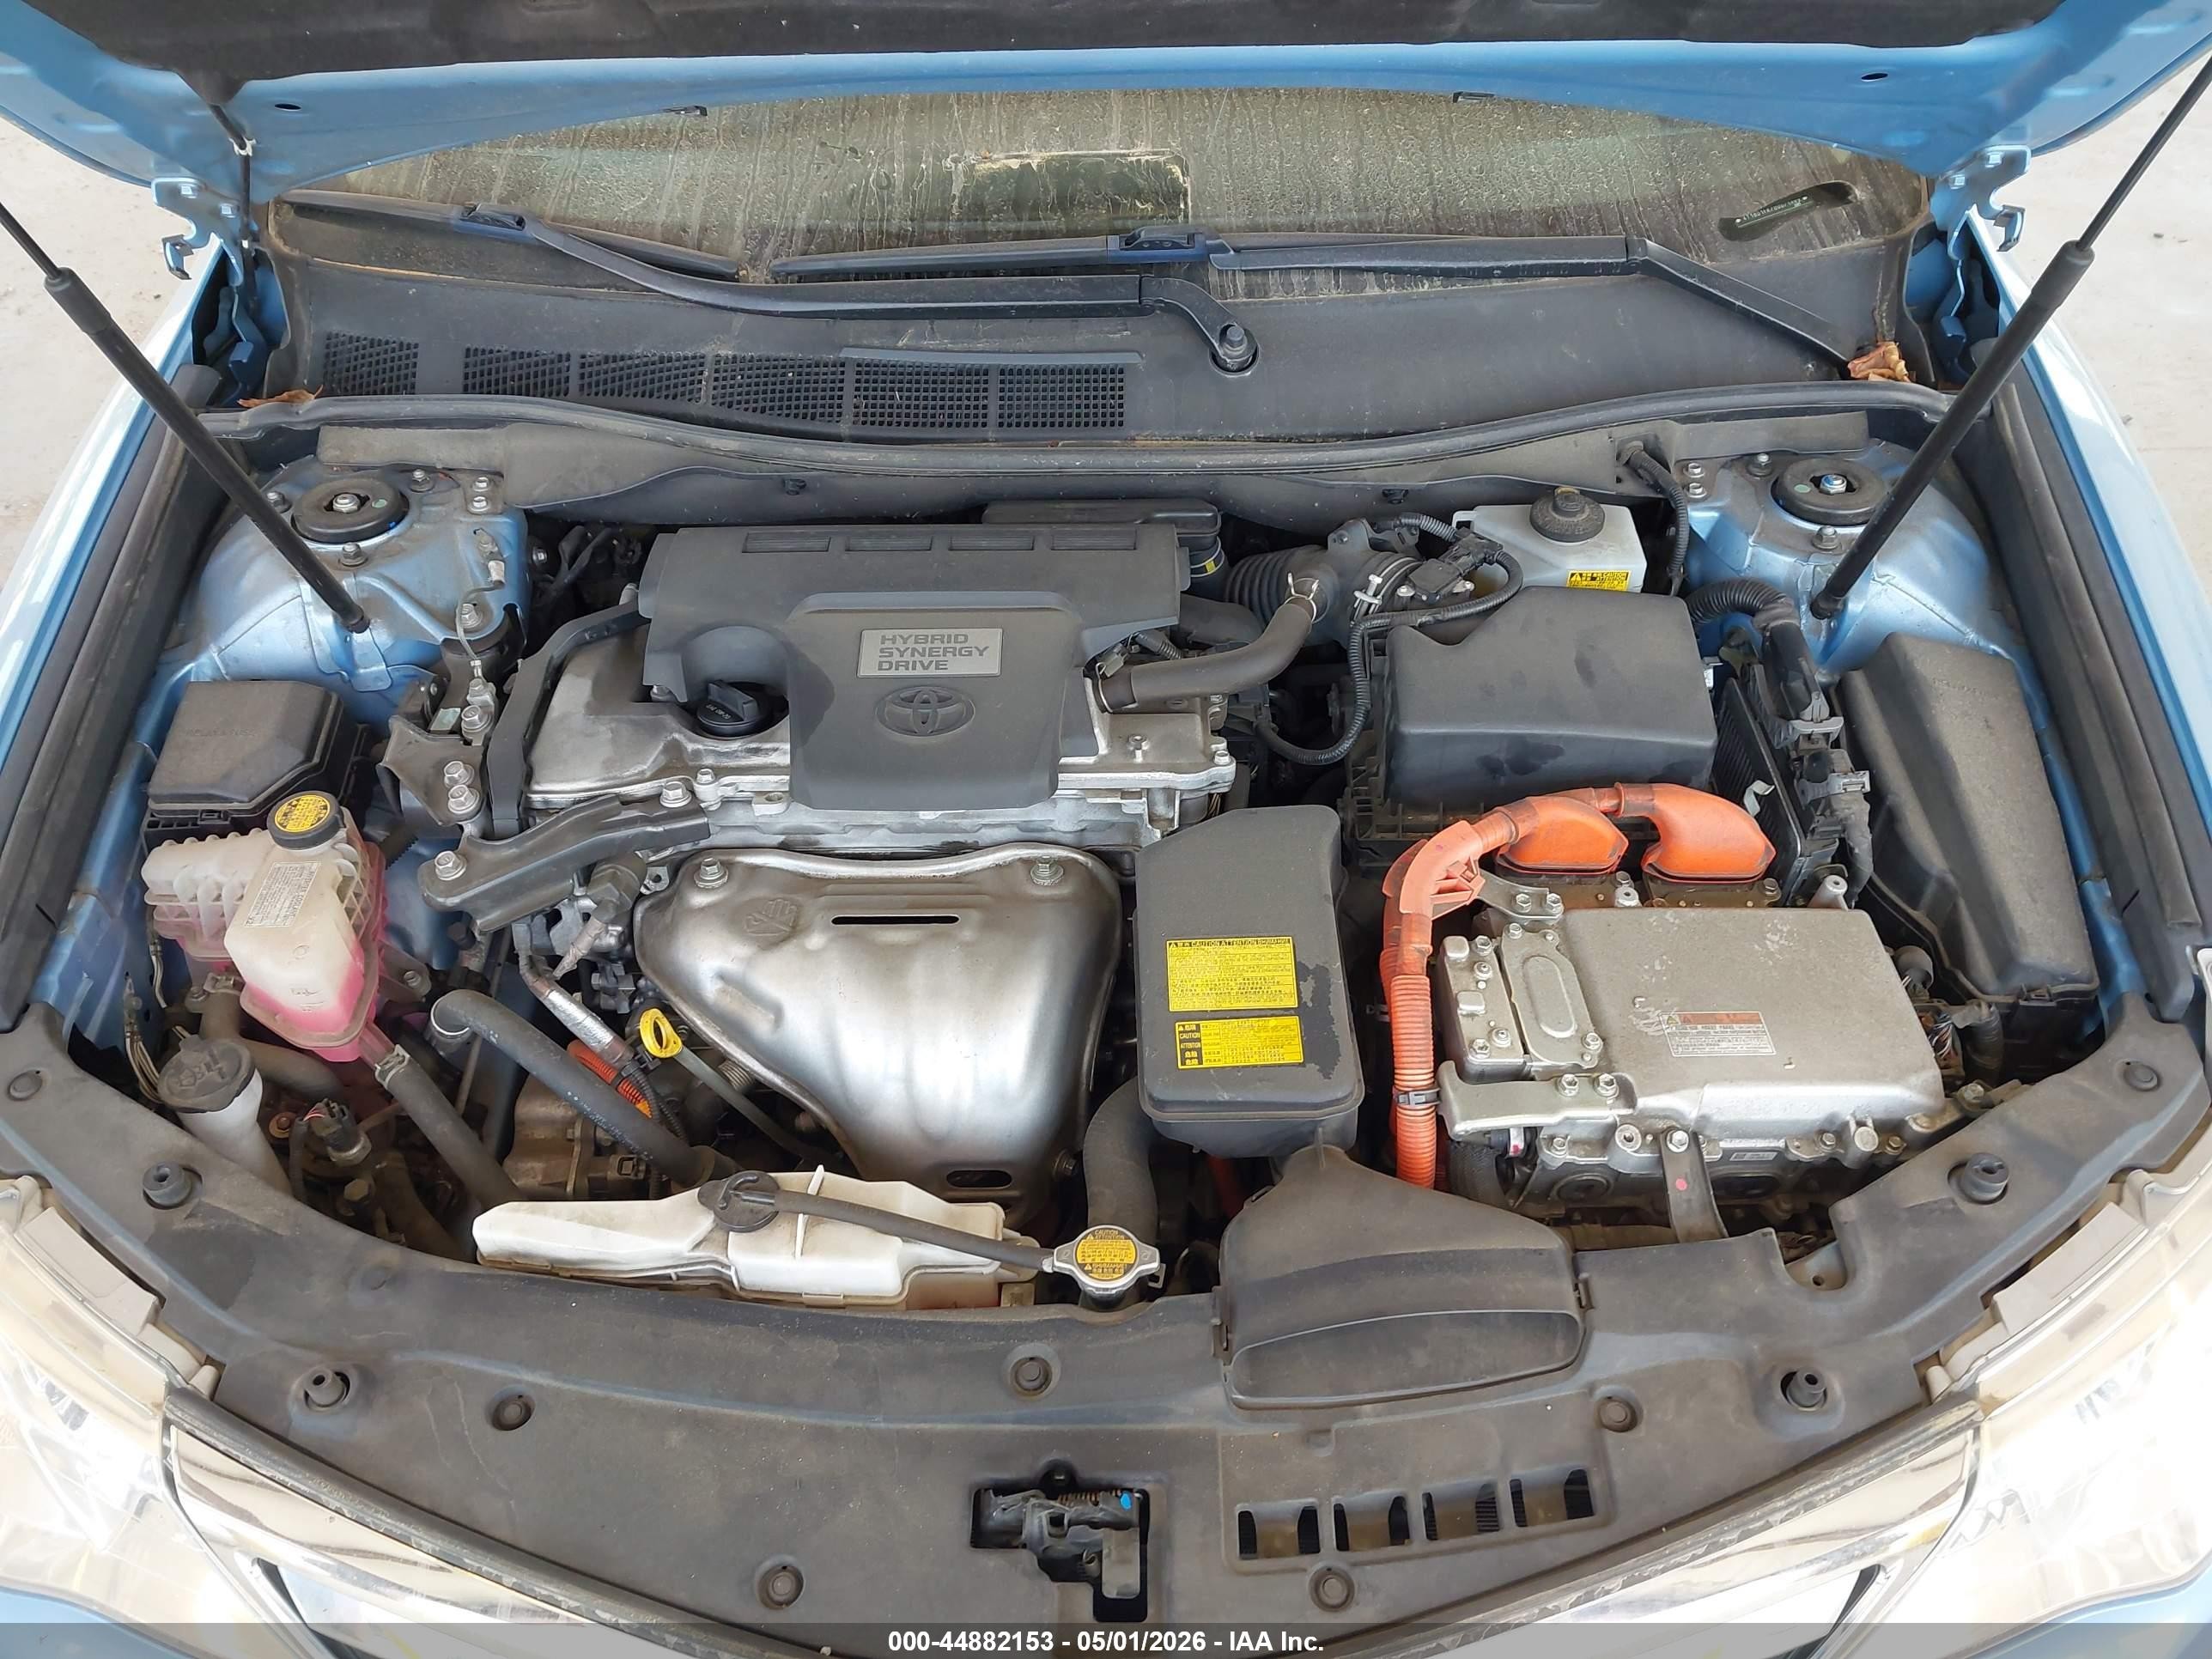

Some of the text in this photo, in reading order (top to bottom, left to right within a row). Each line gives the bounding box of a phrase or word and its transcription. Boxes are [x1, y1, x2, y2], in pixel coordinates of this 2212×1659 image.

[880, 634, 969, 645] HYBRID
[878, 646, 990, 659] SYNERGY
[878, 659, 949, 672] DRIVE
